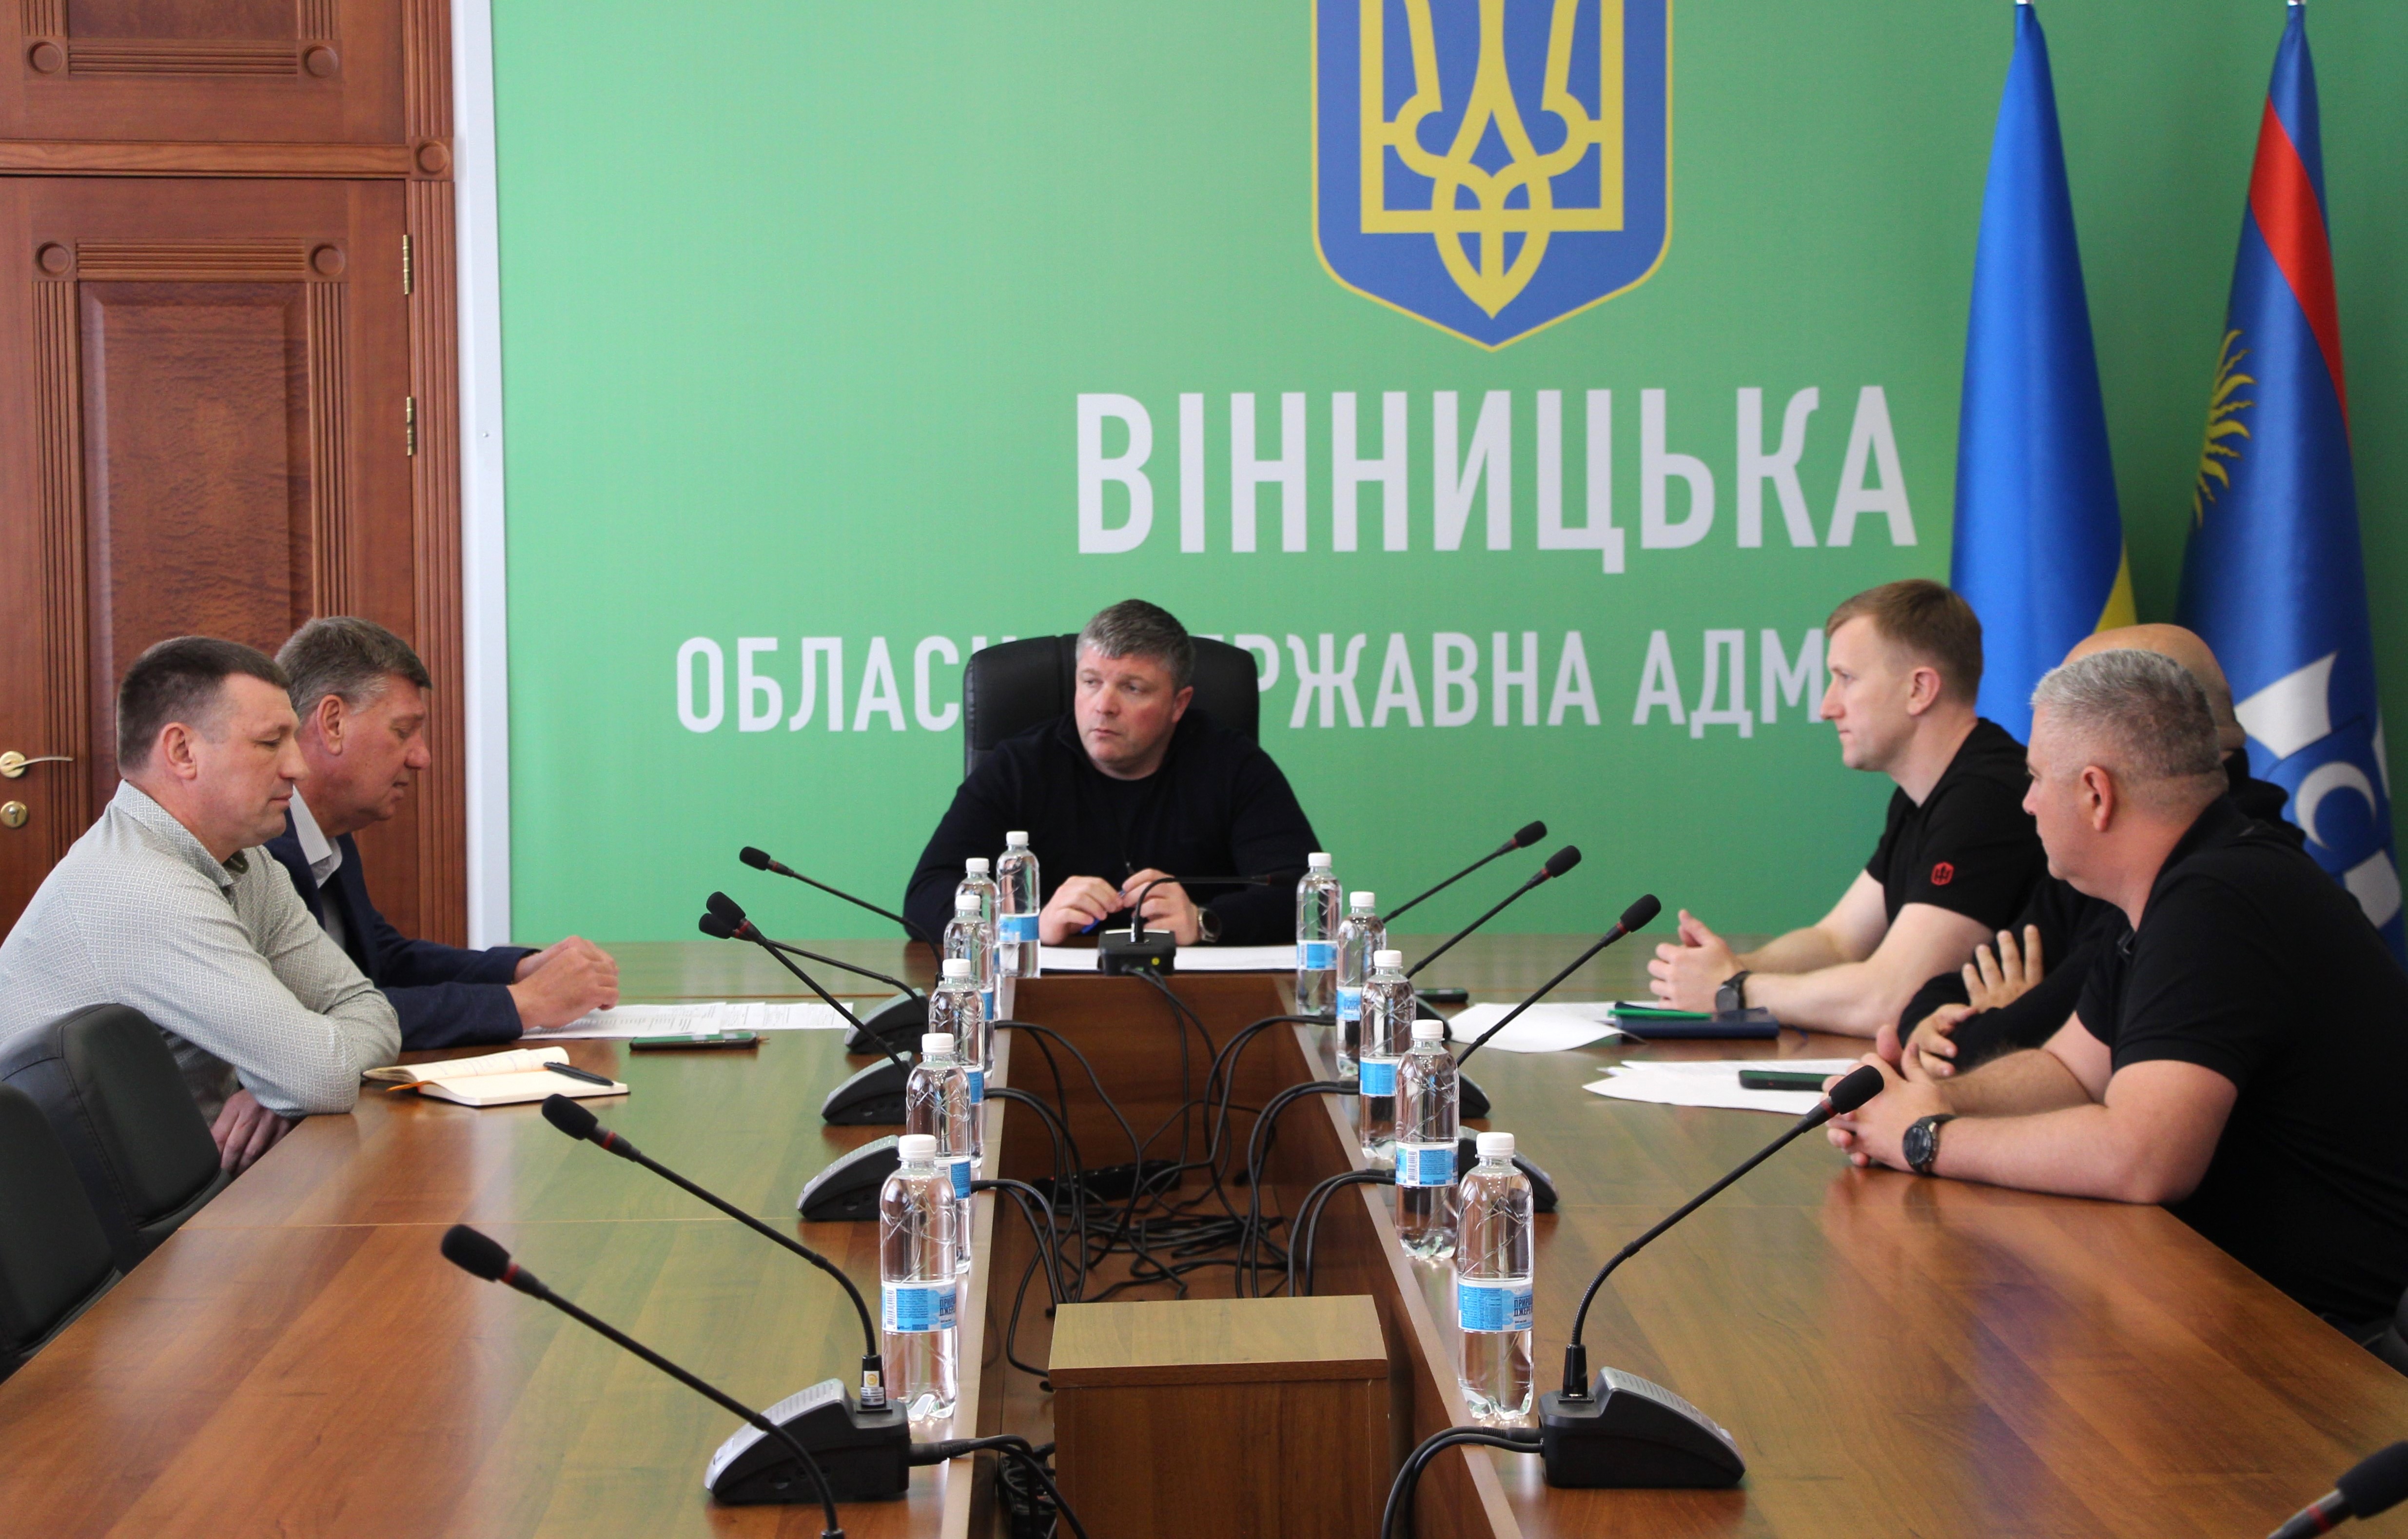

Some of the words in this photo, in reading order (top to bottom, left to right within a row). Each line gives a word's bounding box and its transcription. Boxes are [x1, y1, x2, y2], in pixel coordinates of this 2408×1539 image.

[1077, 385, 1917, 573] ВІННИЦЬКА
[676, 635, 1019, 732] ОБЛАС
[1204, 631, 1601, 729] РЖАВНА
